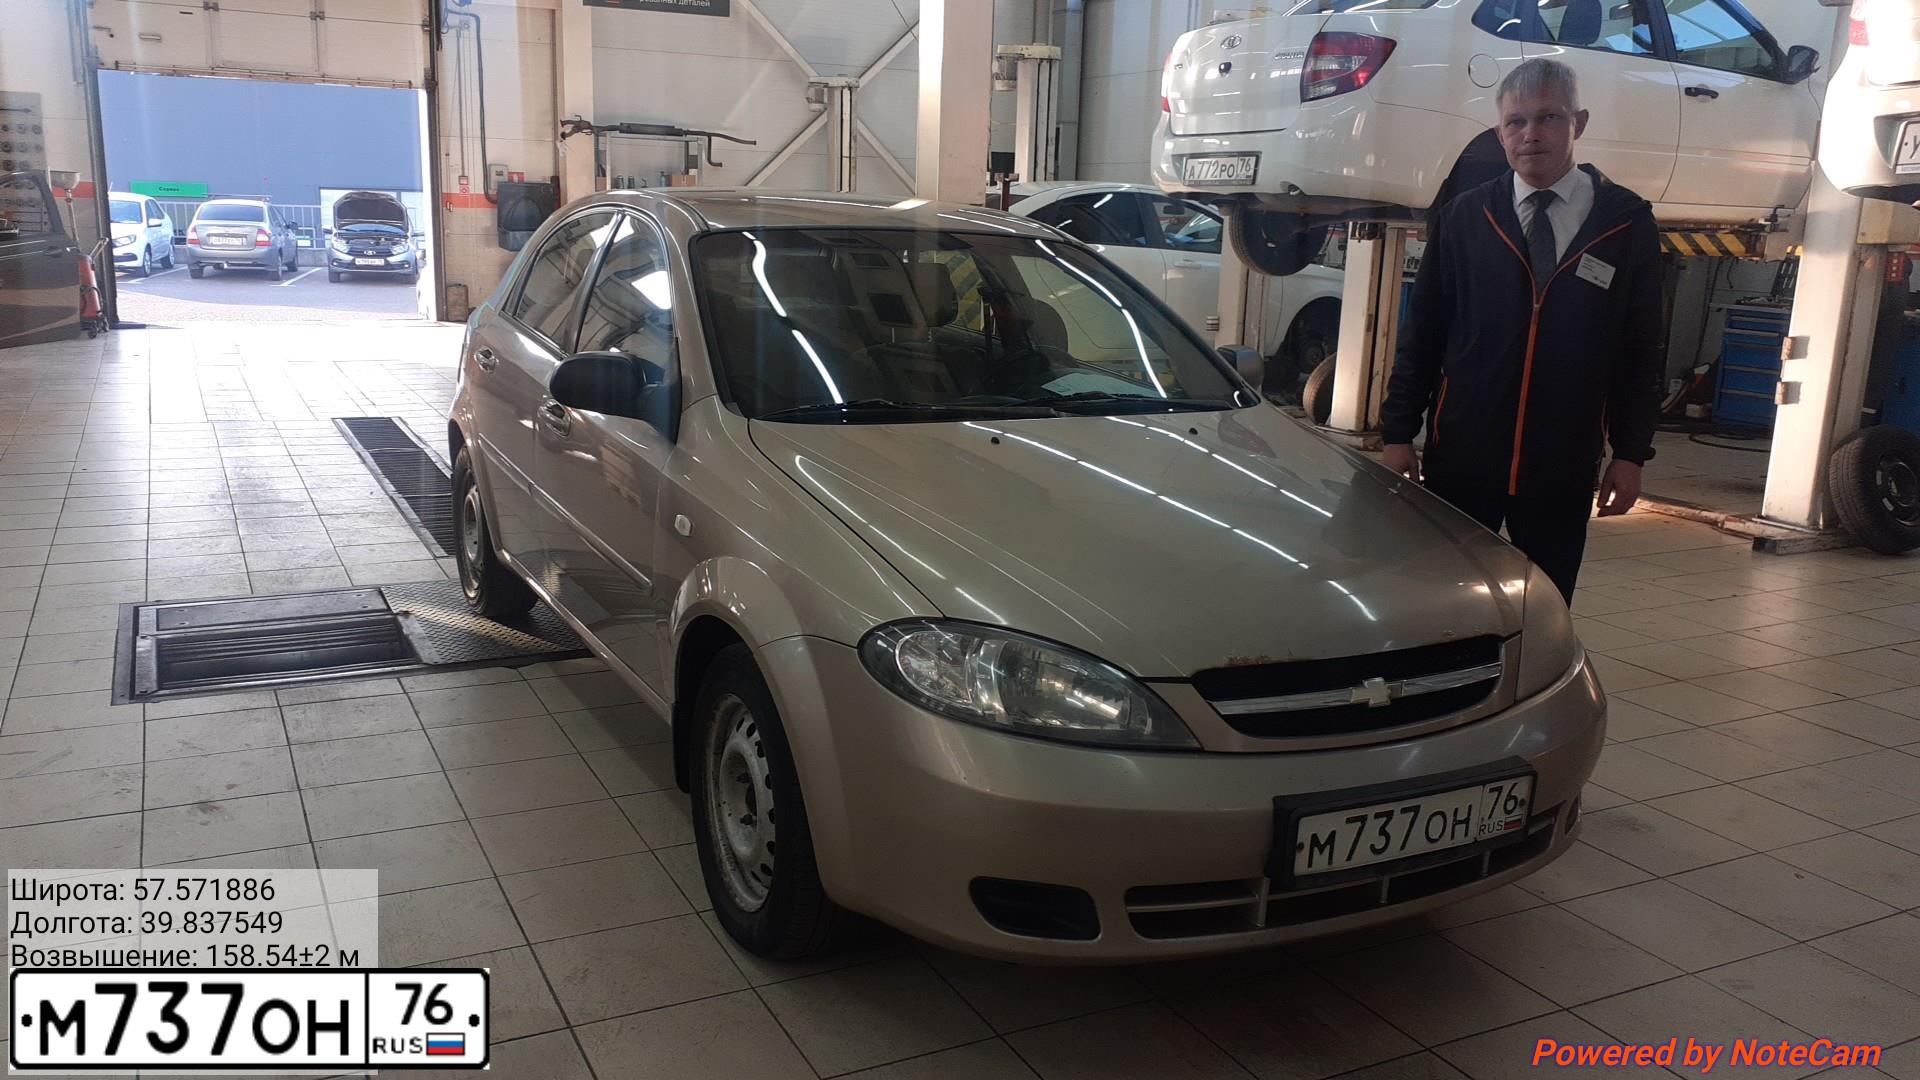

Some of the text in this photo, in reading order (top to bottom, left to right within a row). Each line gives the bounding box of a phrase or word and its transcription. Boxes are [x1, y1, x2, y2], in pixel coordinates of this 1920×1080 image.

[1189, 158, 1251, 179] А772РО 76
[1307, 783, 1518, 868] М737ОН 76
[1479, 820, 1503, 836] RUS
